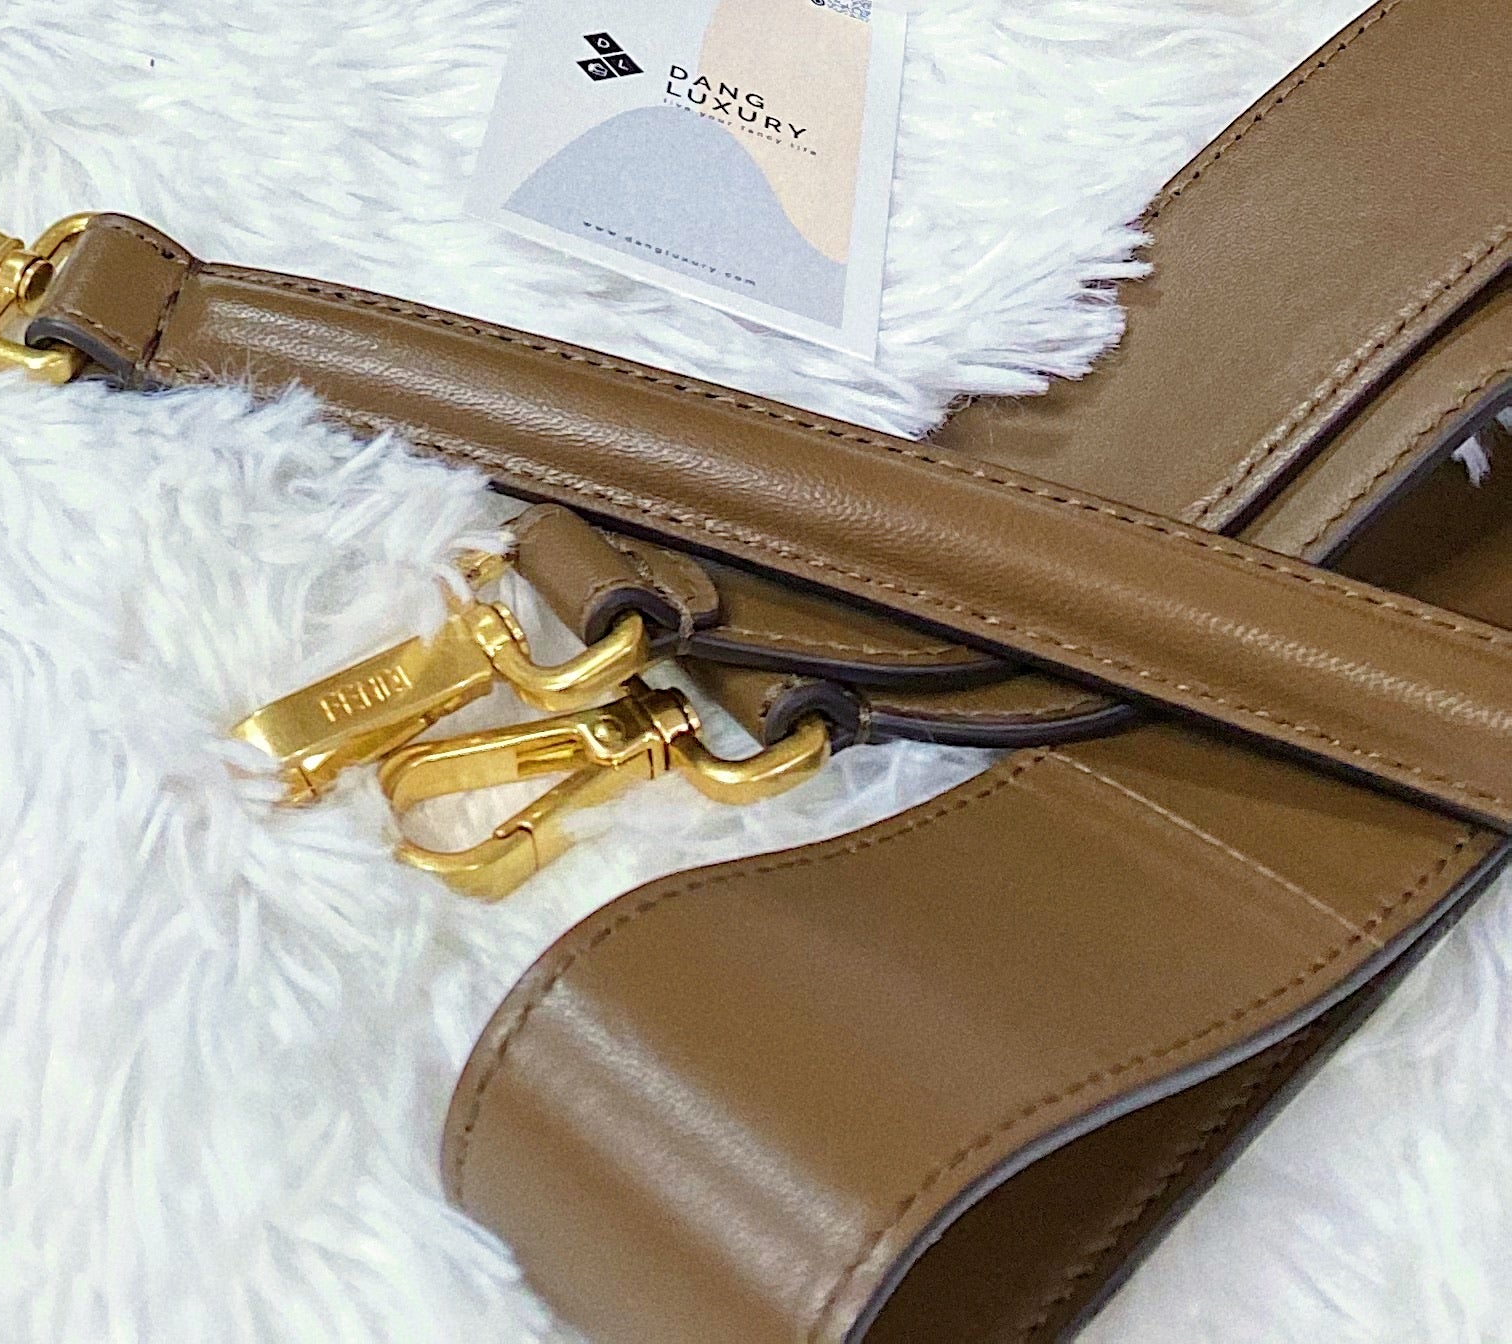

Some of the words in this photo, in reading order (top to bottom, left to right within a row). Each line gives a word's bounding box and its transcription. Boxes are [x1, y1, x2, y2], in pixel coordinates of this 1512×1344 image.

[666, 80, 807, 139] LUXURY
[670, 64, 765, 110] DANG
[583, 220, 756, 286] wwwdangluxurycom
[319, 664, 414, 723] FENDI
